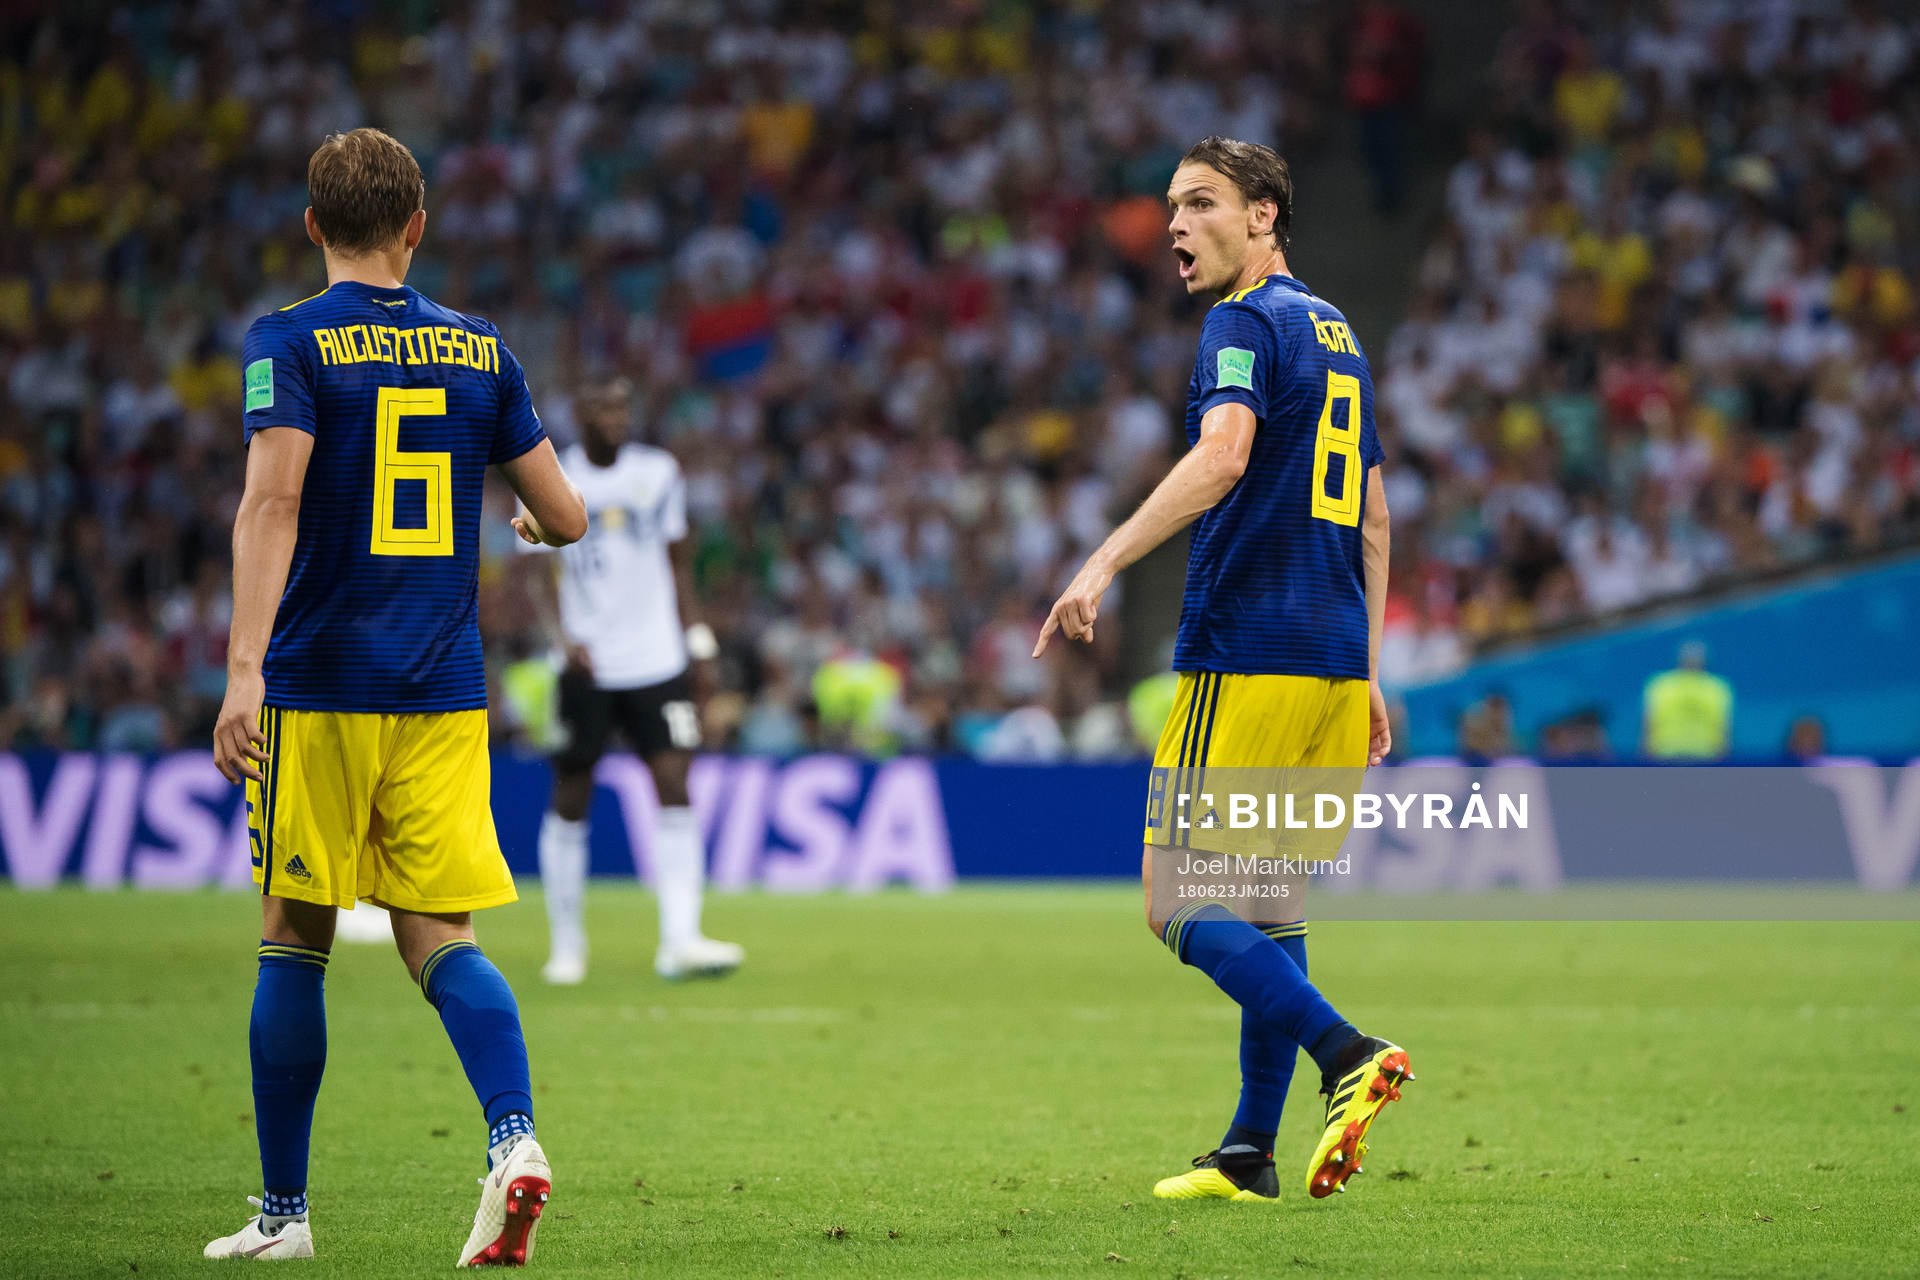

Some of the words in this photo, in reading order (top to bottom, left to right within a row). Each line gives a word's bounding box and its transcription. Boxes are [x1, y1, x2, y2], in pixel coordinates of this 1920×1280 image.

[313, 324, 500, 375] AUGUSTINSSON
[370, 386, 454, 556] 6
[1312, 369, 1362, 528] 8
[1148, 767, 1169, 828] 8
[284, 866, 312, 879] adidas
